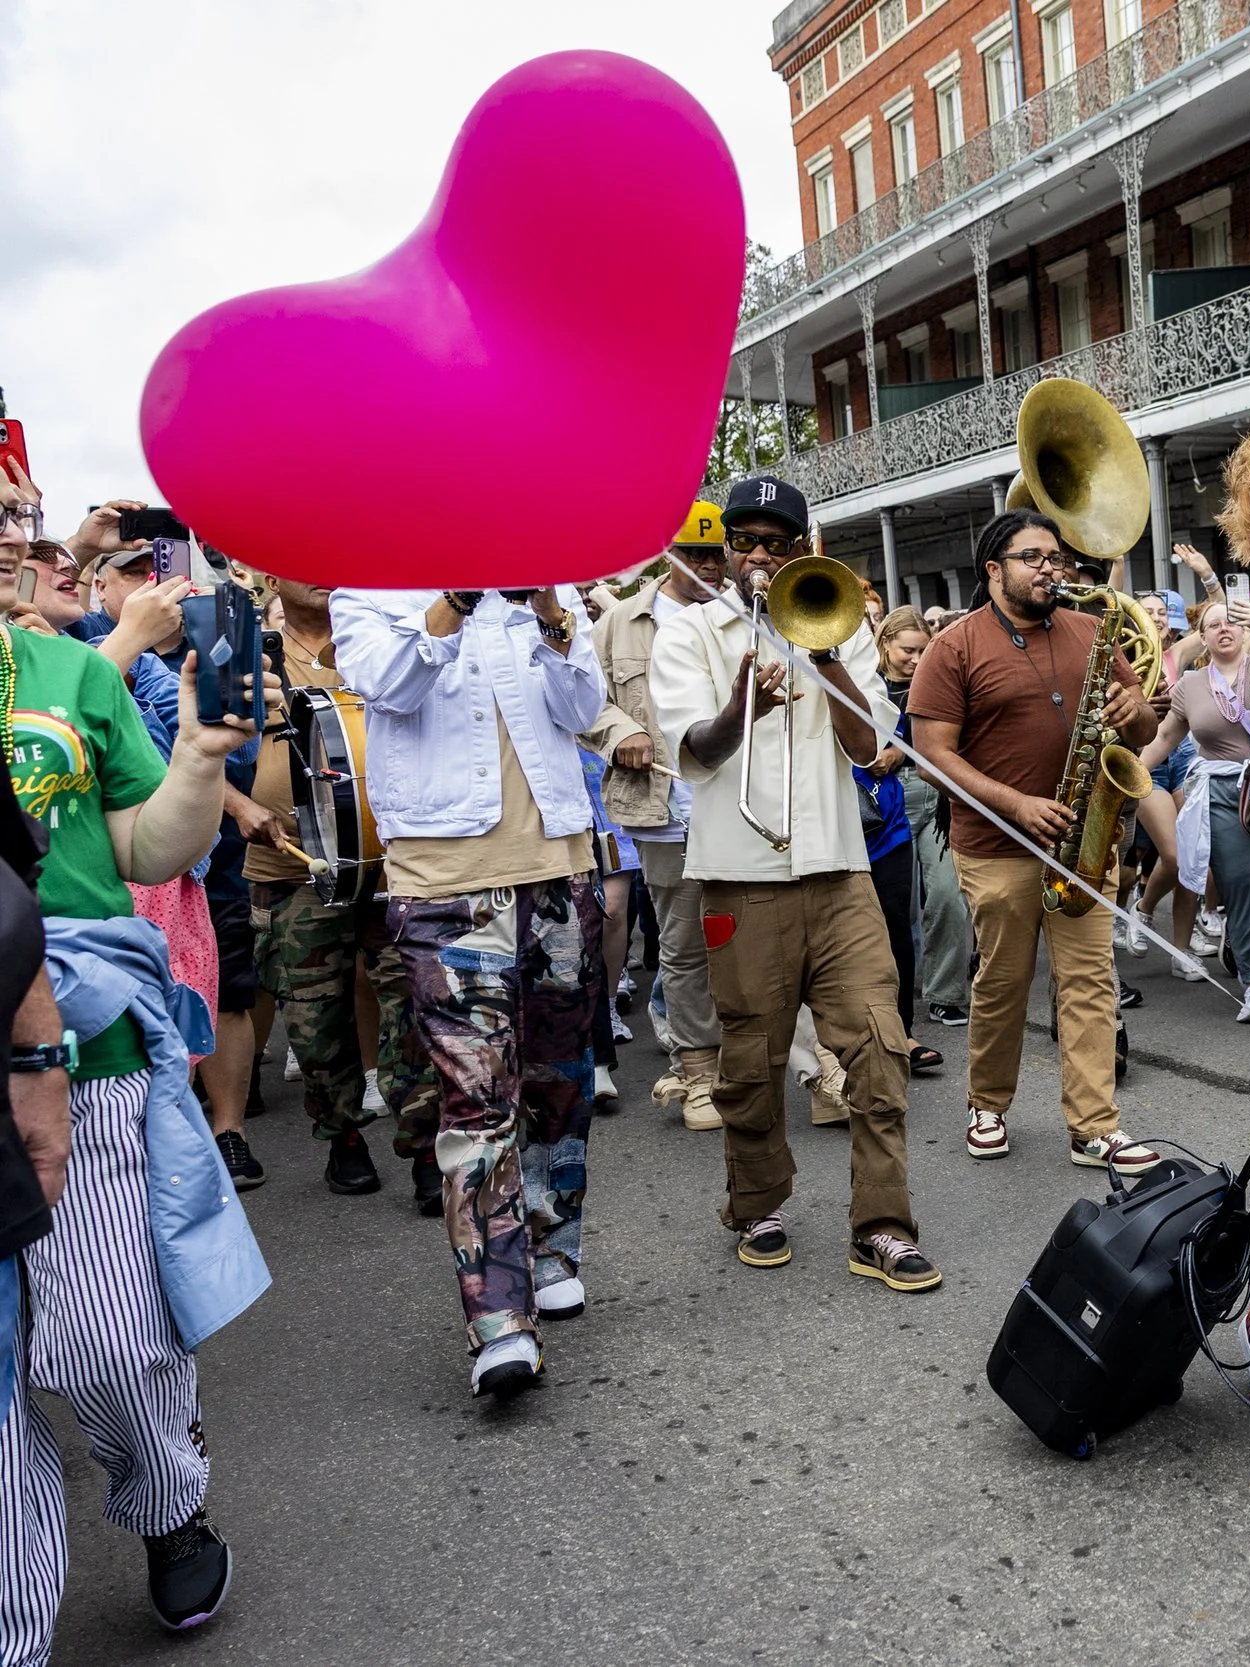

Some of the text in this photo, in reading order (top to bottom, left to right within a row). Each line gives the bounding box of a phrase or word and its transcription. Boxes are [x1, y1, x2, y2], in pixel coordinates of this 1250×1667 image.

[699, 518, 712, 537] P
[13, 743, 45, 764] HE
[11, 767, 94, 819] nigans
